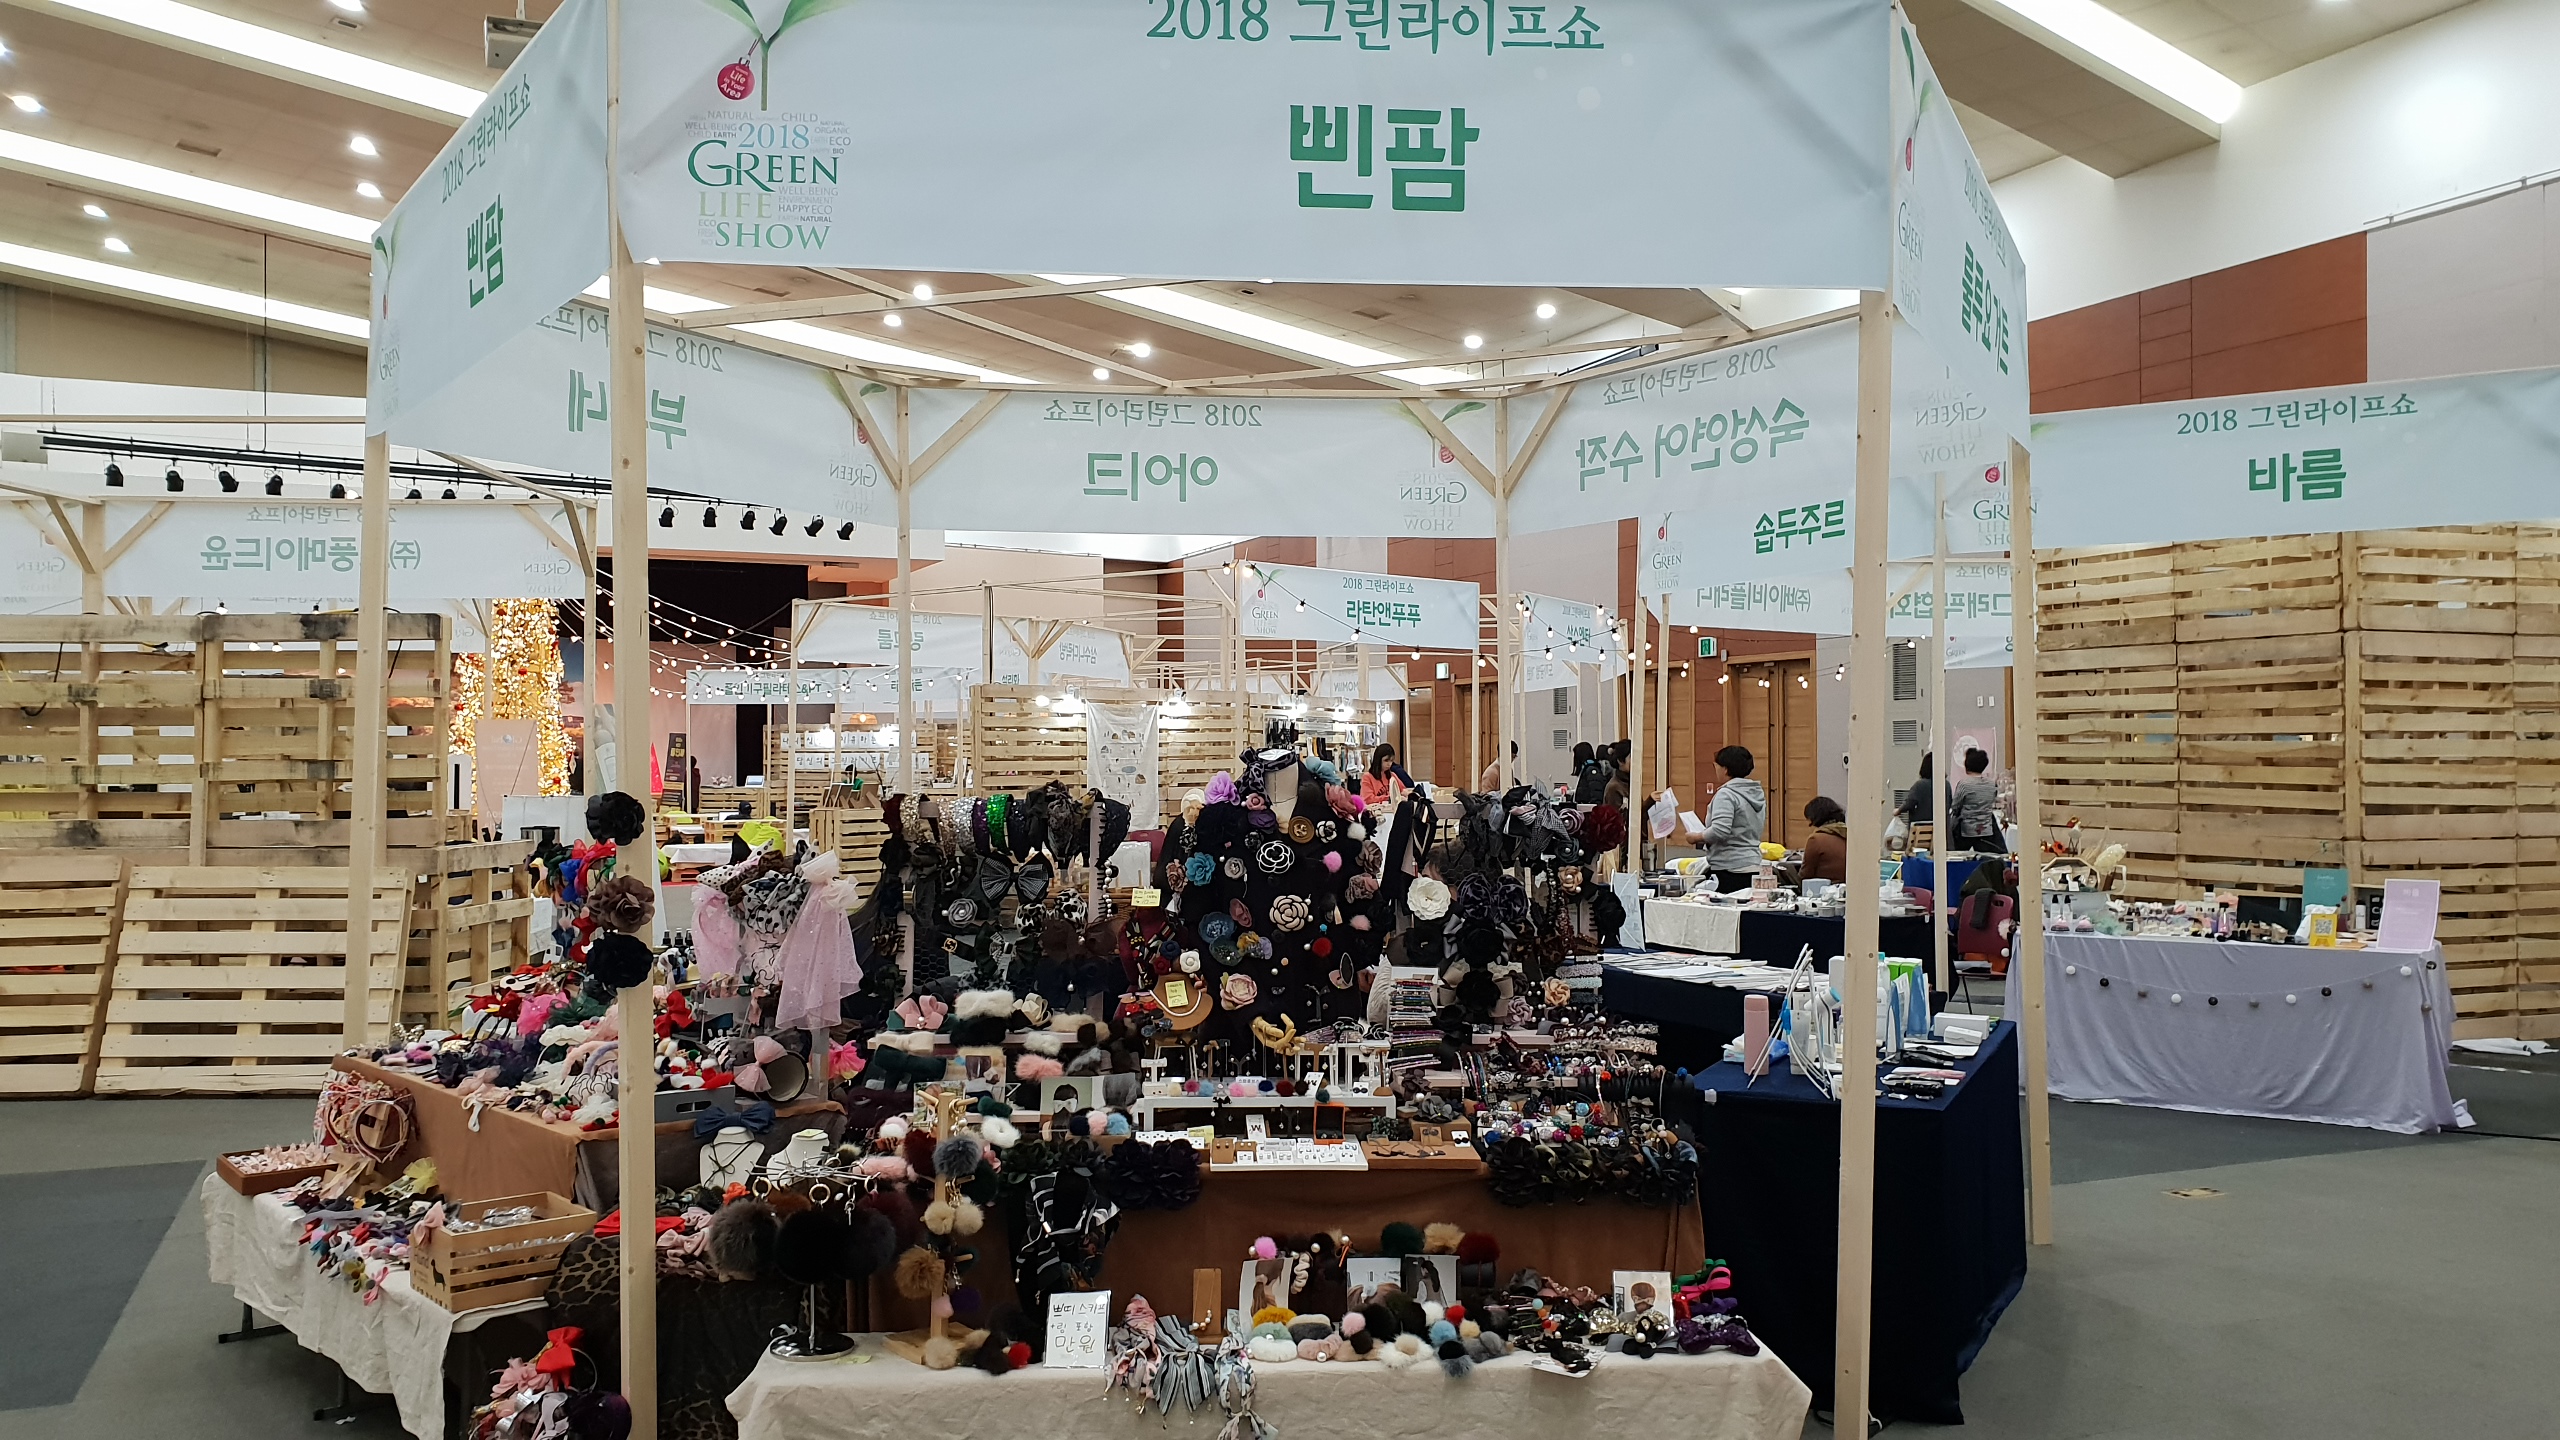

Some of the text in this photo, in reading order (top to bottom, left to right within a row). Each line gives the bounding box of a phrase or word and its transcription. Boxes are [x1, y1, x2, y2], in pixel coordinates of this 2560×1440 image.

[1146, 0, 1604, 56] 2018 그린라이프쇼
[730, 70, 746, 84] Life
[720, 83, 741, 98] Area
[707, 110, 754, 121] NATURAL
[781, 112, 818, 122] CHILD
[685, 122, 737, 131] WELL BEING
[738, 122, 810, 149] 2018
[814, 126, 850, 134] ORGANIC
[442, 74, 531, 204] 2018 그린라이프쇼
[829, 136, 851, 146] ECO
[688, 139, 839, 192] GREEN
[1290, 104, 1480, 212] 삔팜
[778, 186, 838, 196] WELL BEING
[778, 196, 833, 204] ENVIRONMENT
[699, 191, 772, 218] LIFE
[778, 204, 833, 214] HAPPY ECO
[698, 219, 717, 227] ECO
[800, 215, 832, 223] NATURAL
[715, 222, 831, 250] SHOW
[1898, 201, 1924, 263] GREEN
[467, 193, 504, 309] 삔팜
[2177, 392, 2419, 435] 2018 그린라이프쇼
[2248, 448, 2347, 503] 바름
[1973, 499, 2038, 521] GRN
[1753, 499, 1846, 555] 솝두주르
[1652, 552, 1682, 570] GREEN
[1342, 577, 1415, 595] 2018 그린라이프쇼
[1657, 578, 1680, 590] SHOW
[1252, 606, 1279, 620] GREEN
[1346, 599, 1421, 628] 라탄앤푸푸
[1256, 626, 1277, 634] SHOW
